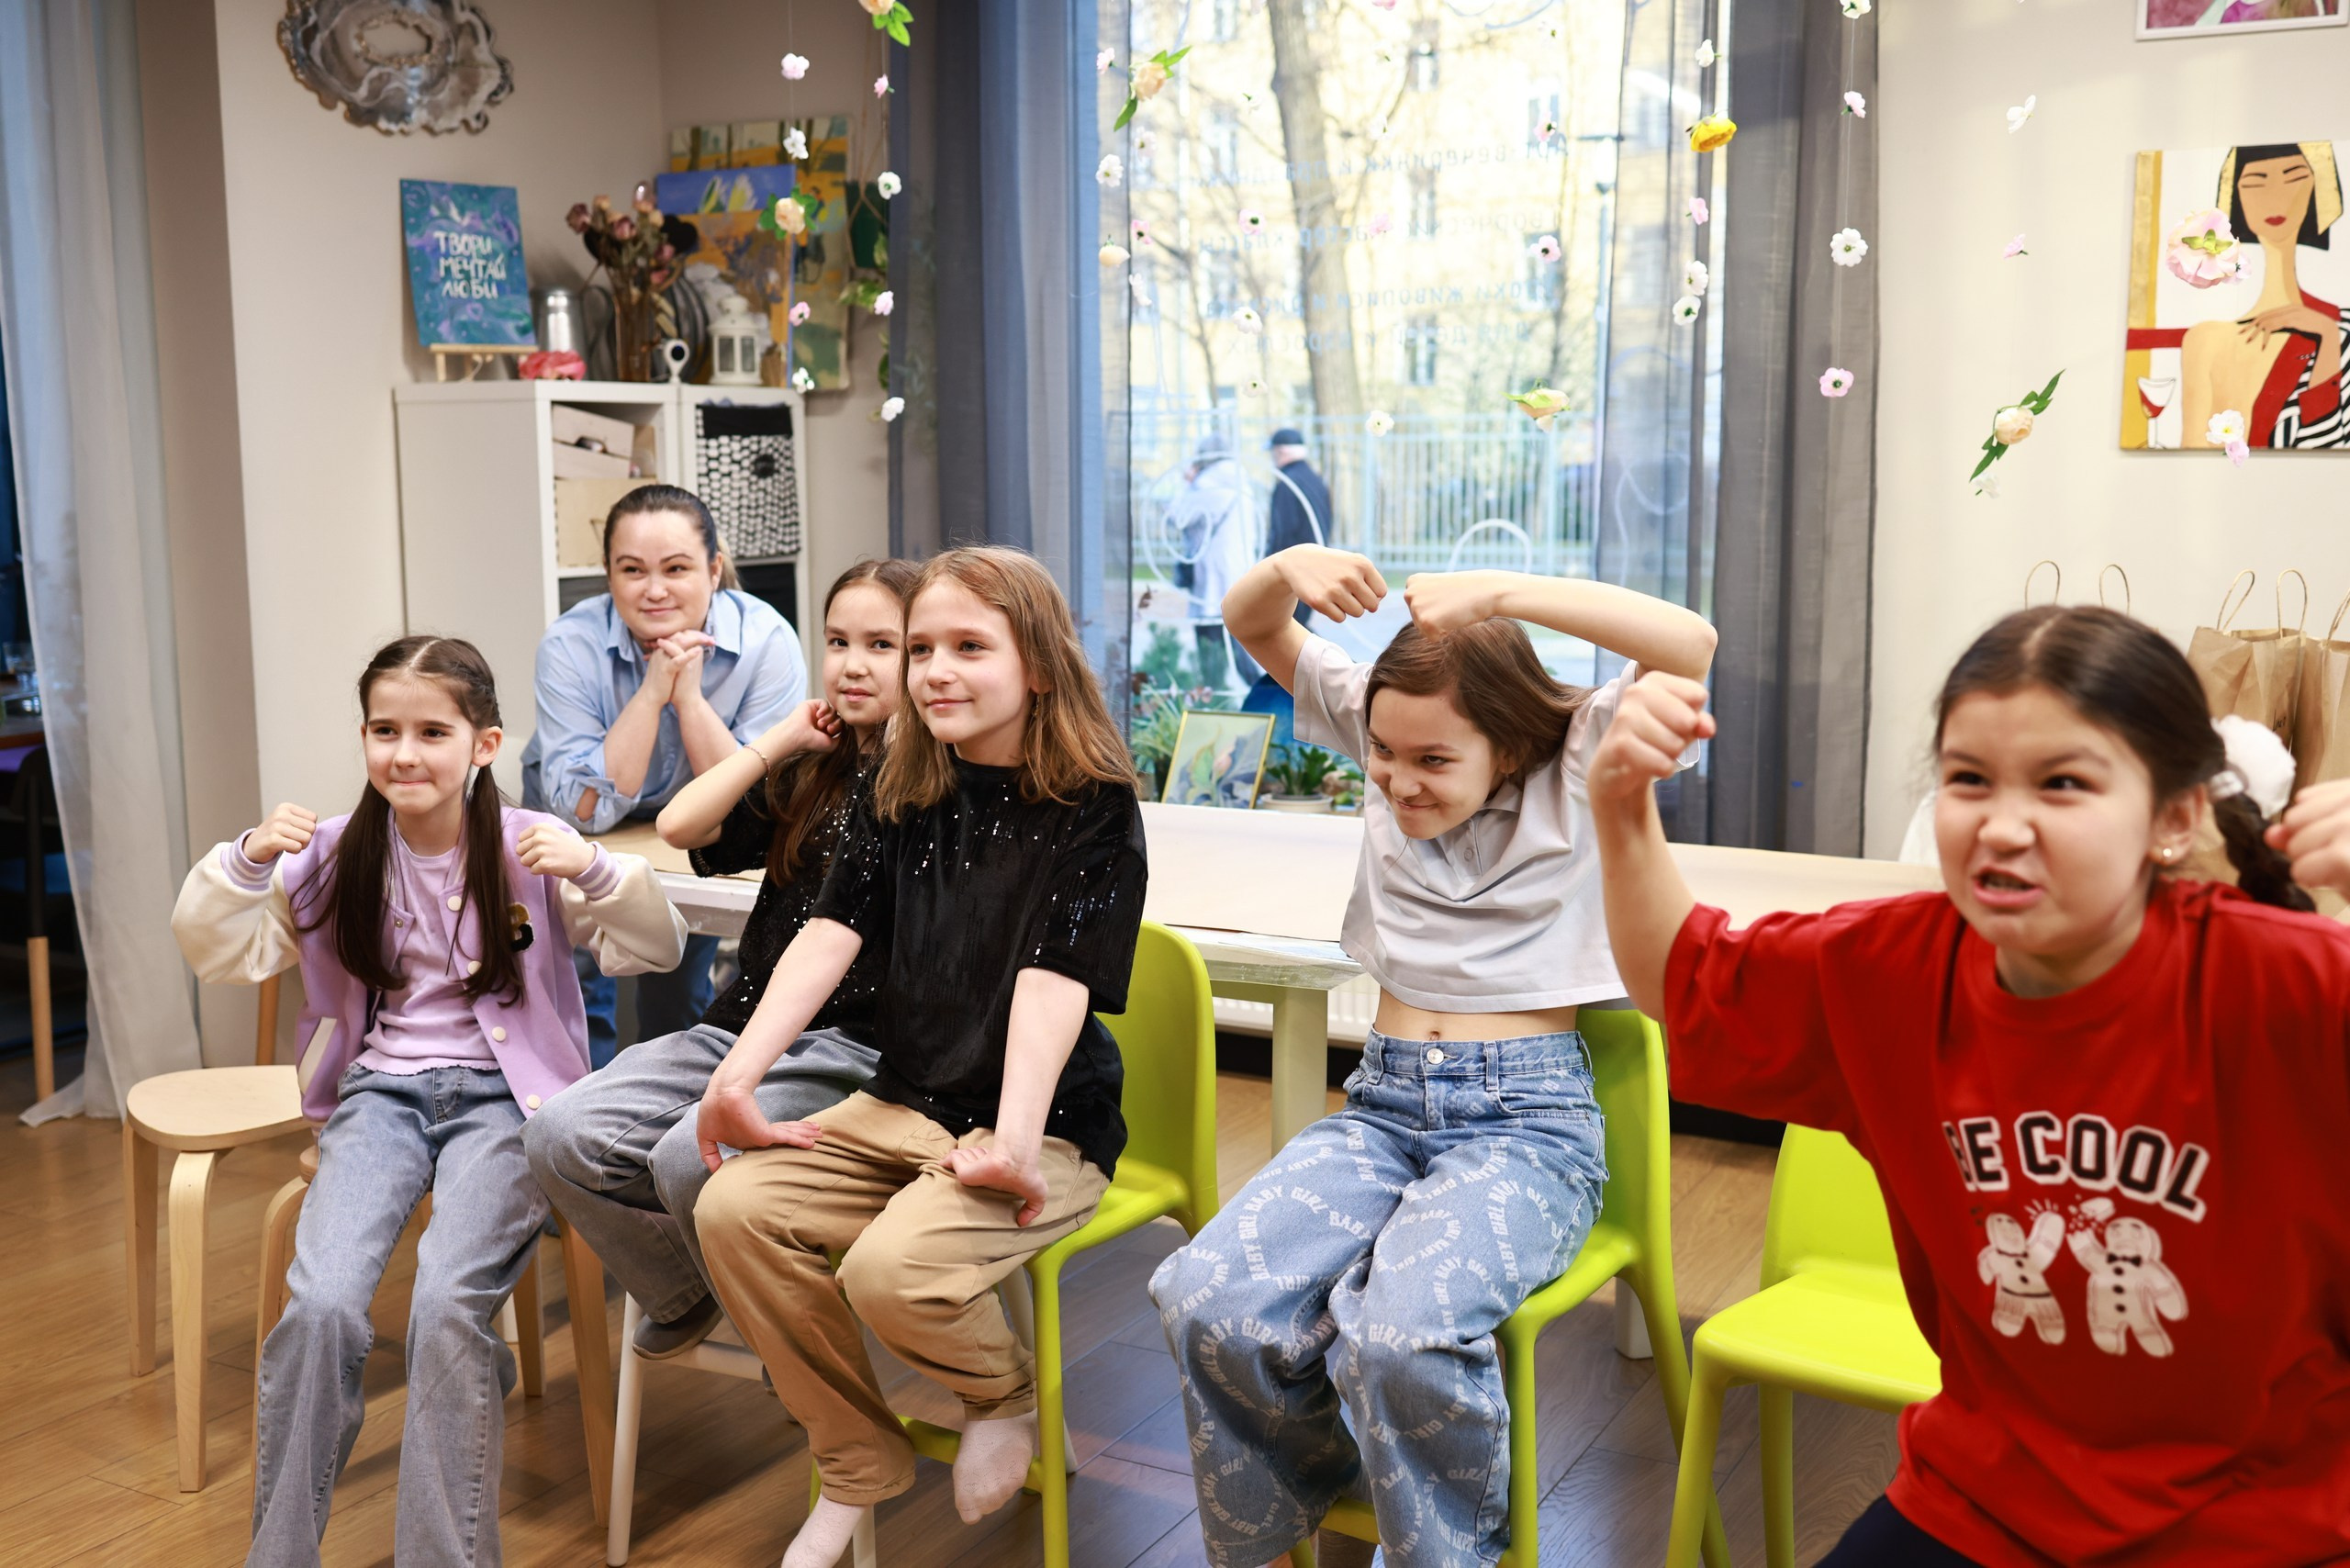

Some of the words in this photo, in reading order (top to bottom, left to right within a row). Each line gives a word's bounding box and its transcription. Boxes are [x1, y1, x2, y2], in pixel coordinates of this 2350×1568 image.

[433, 230, 493, 259] ТВОРИ
[439, 253, 507, 281] МЕЧТАЙ
[442, 280, 498, 300] ЛЮБИ
[1942, 1116, 2009, 1192] E
[2014, 1110, 2210, 1224] COOL
[1244, 1185, 1283, 1213] BABY
[1291, 1186, 1328, 1215] GIRL
[1425, 1177, 1458, 1201] GIRL
[1488, 1180, 1521, 1204] BABY
[1238, 1214, 1259, 1240] GIRL
[1329, 1210, 1372, 1240] BABY
[1487, 1204, 1509, 1237] GIRL
[1191, 1248, 1225, 1263] BABY
[1243, 1243, 1271, 1282] BABY
[1497, 1240, 1520, 1282] BABY
[1208, 1263, 1229, 1288] GIRL
[1434, 1256, 1461, 1281] BABY
[1467, 1259, 1492, 1285] GIRL
[1181, 1286, 1214, 1313] BABY
[1200, 1316, 1235, 1356] BABY
[1241, 1316, 1280, 1345] GIRL
[1369, 1322, 1407, 1352] GIRL
[1404, 1419, 1445, 1440] GIRL
[1220, 1456, 1244, 1476] GIRL
[1201, 1472, 1219, 1499] BABY
[1208, 1499, 1232, 1522] GIRL
